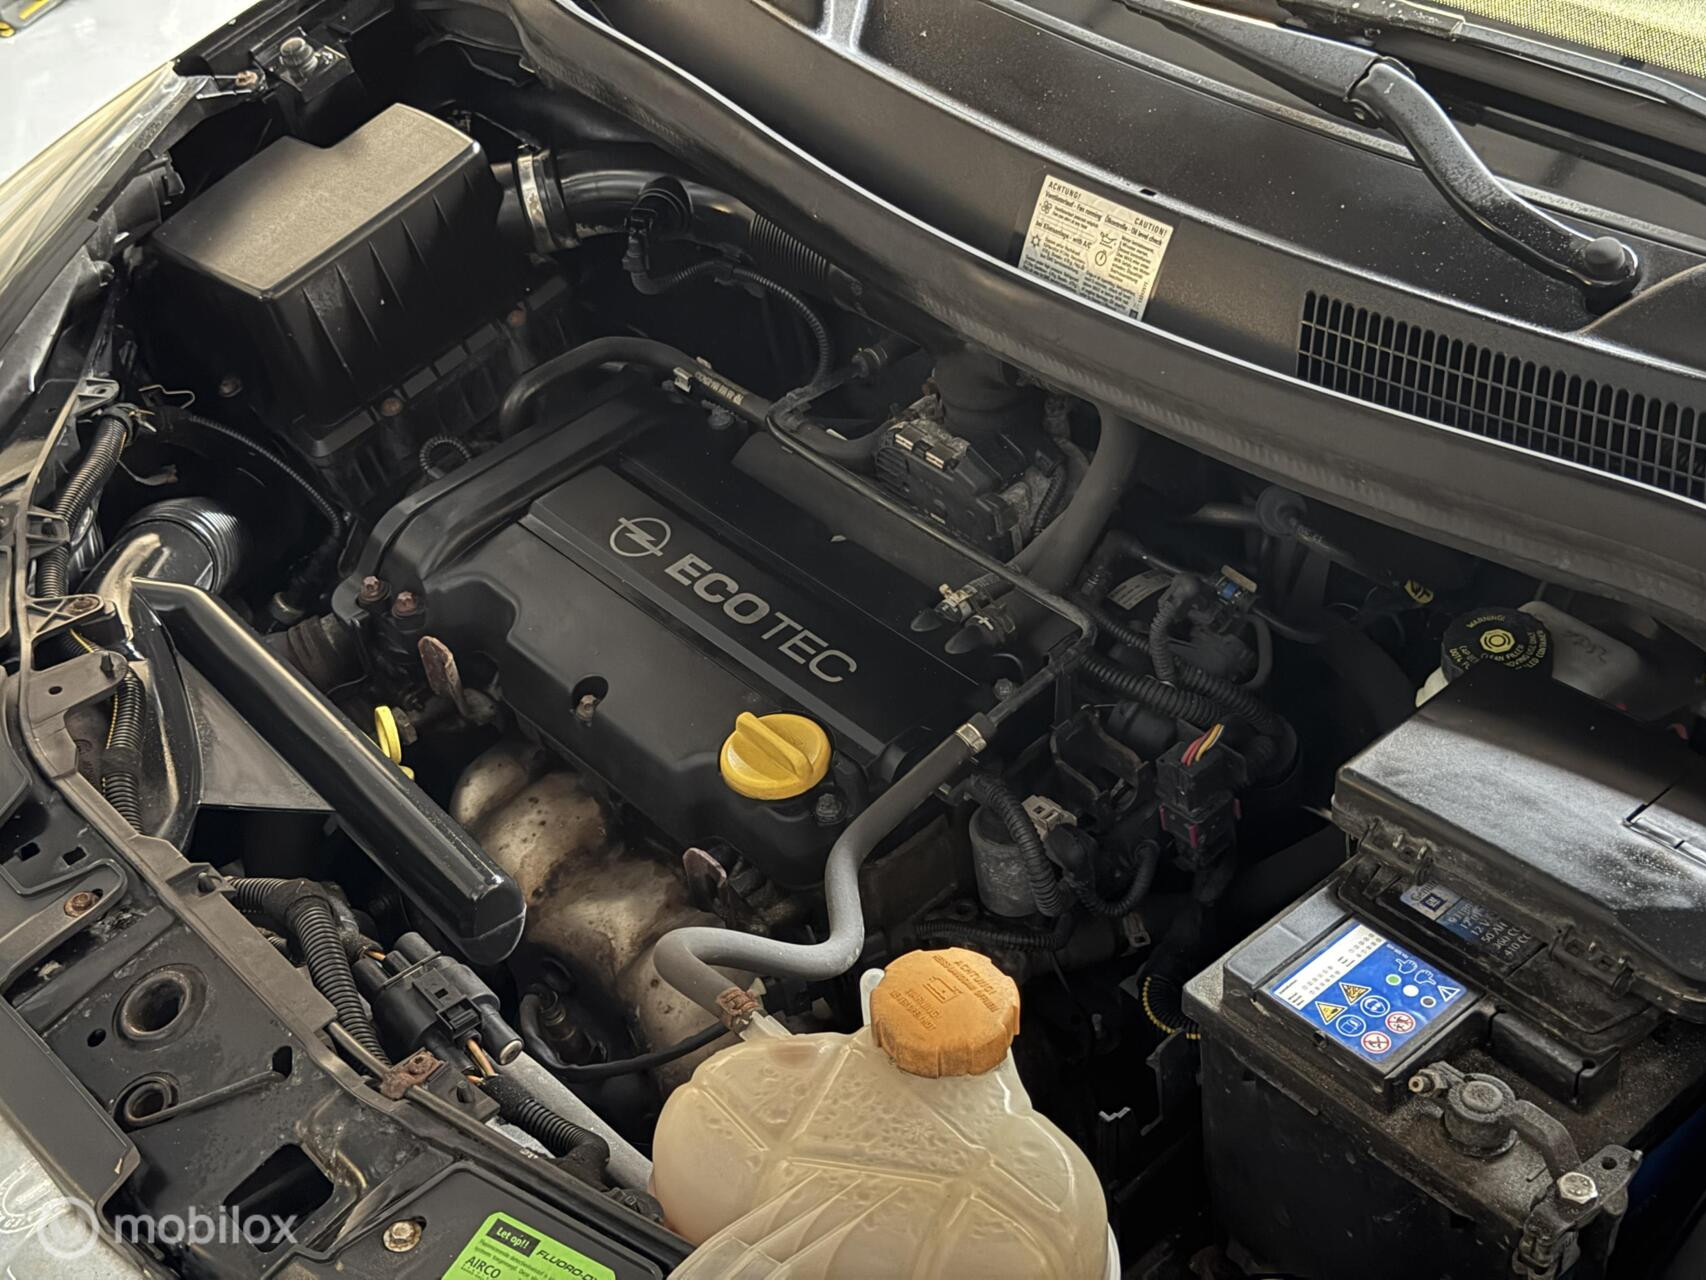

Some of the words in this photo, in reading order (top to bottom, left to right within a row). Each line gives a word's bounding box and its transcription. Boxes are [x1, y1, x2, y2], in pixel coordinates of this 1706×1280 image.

[1048, 181, 1082, 200] ACHTUNG!
[1134, 217, 1168, 237] CAUTION!
[664, 552, 858, 683] ECOTEC
[496, 1227, 511, 1240] Let
[465, 1256, 502, 1280] AIRCO
